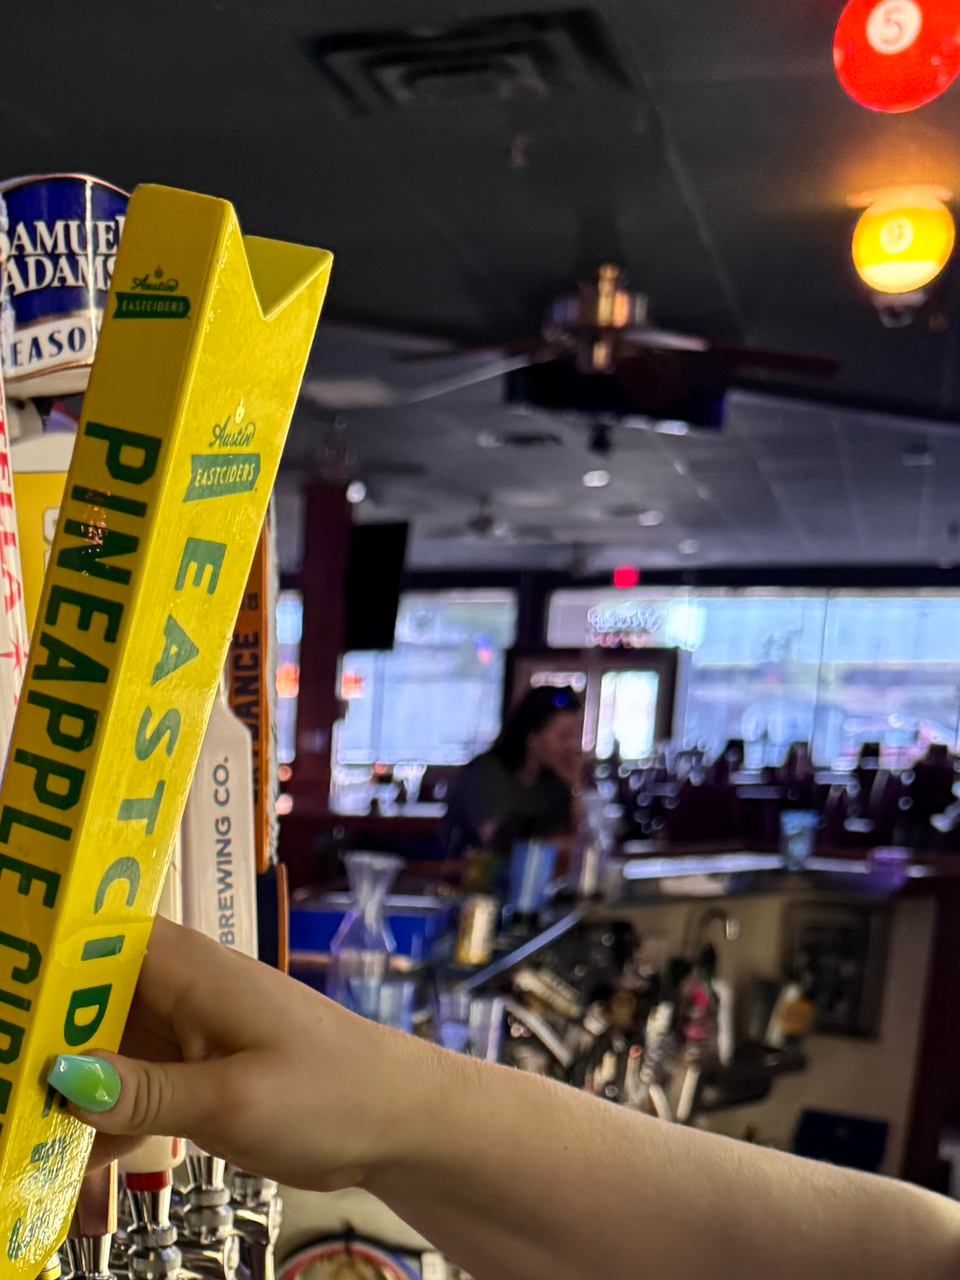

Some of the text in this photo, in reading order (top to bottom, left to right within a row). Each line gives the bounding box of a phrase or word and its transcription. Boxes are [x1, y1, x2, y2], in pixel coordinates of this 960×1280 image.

[130, 273, 179, 293] Austin
[121, 299, 184, 313] EASTCIDERS
[2, 325, 102, 369] EASO
[208, 414, 256, 449] Austin
[194, 463, 256, 487] EASTCIDERS
[233, 630, 259, 804] ANCE
[212, 756, 235, 946] BREWING CO.
[6, 537, 227, 1261] EASTCIDRS
